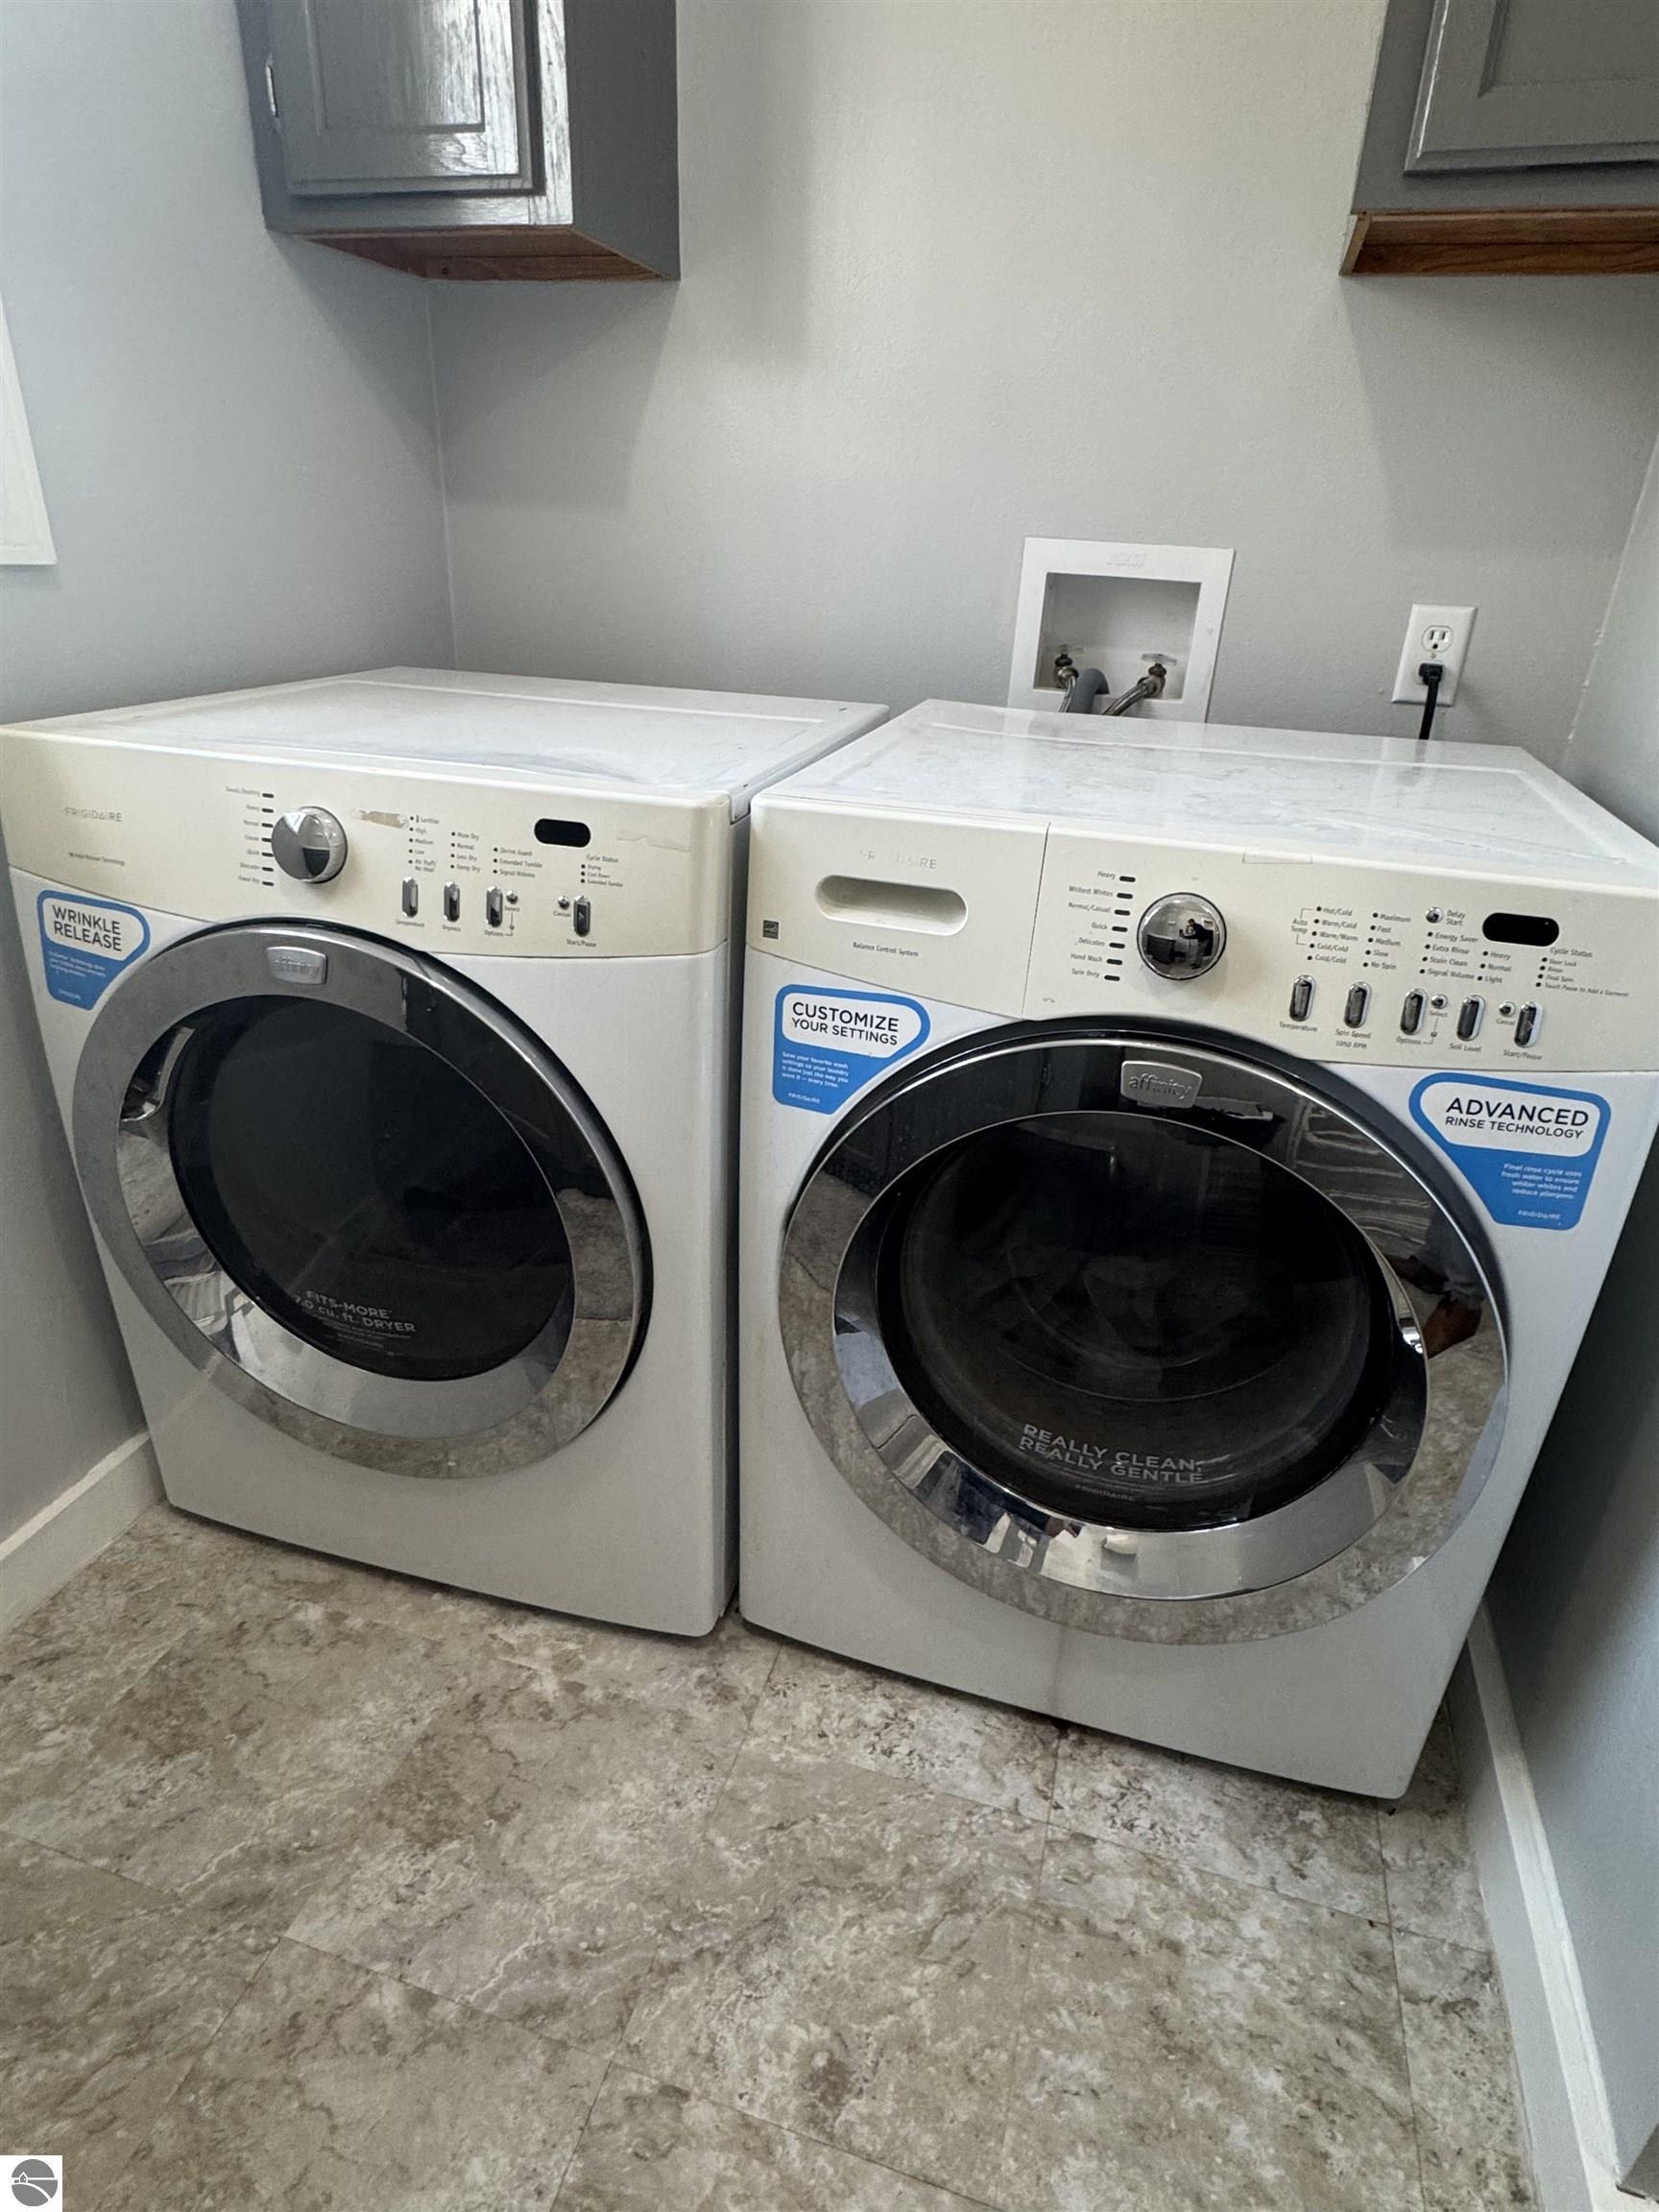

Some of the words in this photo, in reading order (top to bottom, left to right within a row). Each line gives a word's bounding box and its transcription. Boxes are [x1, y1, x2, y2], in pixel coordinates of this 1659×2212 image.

[52, 904, 120, 935] WRINKLE
[54, 921, 122, 951] RELEASE
[792, 1001, 900, 1033] CUSTOMIZE
[792, 1018, 828, 1034] YOUR
[832, 1024, 899, 1046] SETTINGS
[1446, 1097, 1589, 1126] ADVANCED
[1445, 1116, 1485, 1129] RINSE
[1490, 1120, 1584, 1140] TECHNOLOGY
[362, 1316, 417, 1333] DRYER
[1019, 1436, 1103, 1471] REALLY
[1110, 1464, 1203, 1484] GENTLE
[1022, 1423, 1109, 1458] REALLY
[1115, 1452, 1202, 1472] CLEAN,
